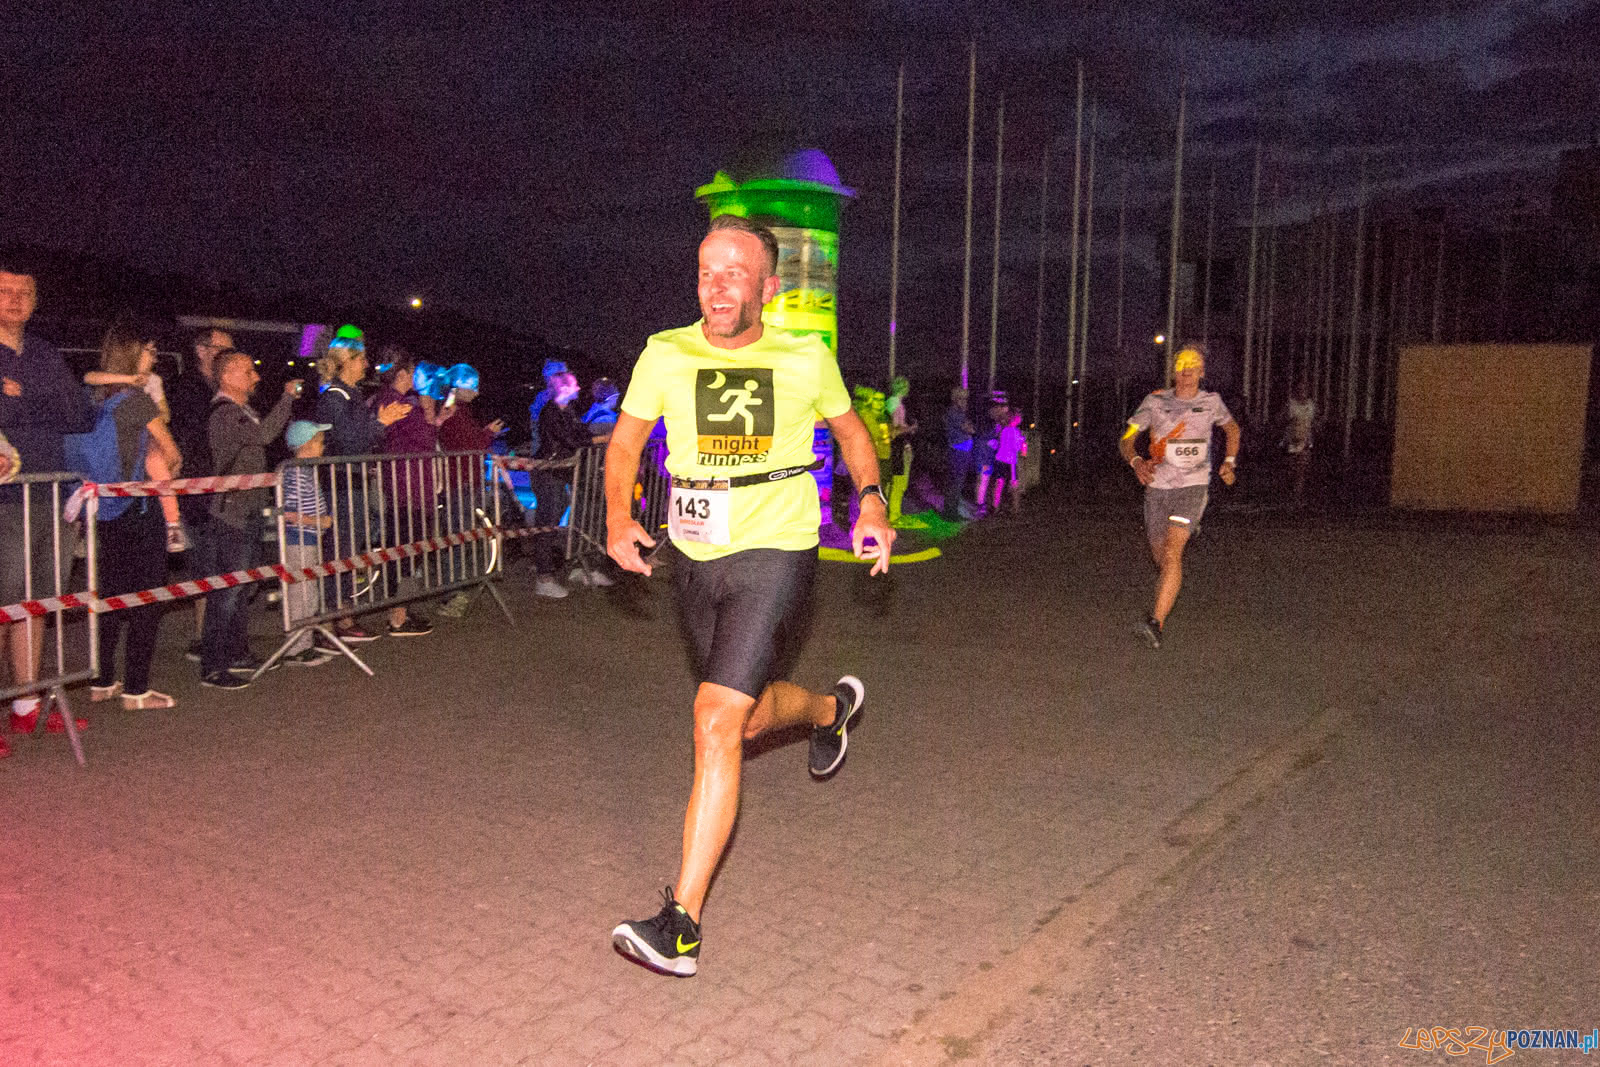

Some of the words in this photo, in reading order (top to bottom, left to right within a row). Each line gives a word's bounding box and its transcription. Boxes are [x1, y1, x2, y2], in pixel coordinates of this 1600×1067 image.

[712, 436, 760, 453] night
[1175, 446, 1199, 456] 666
[675, 495, 711, 519] 143
